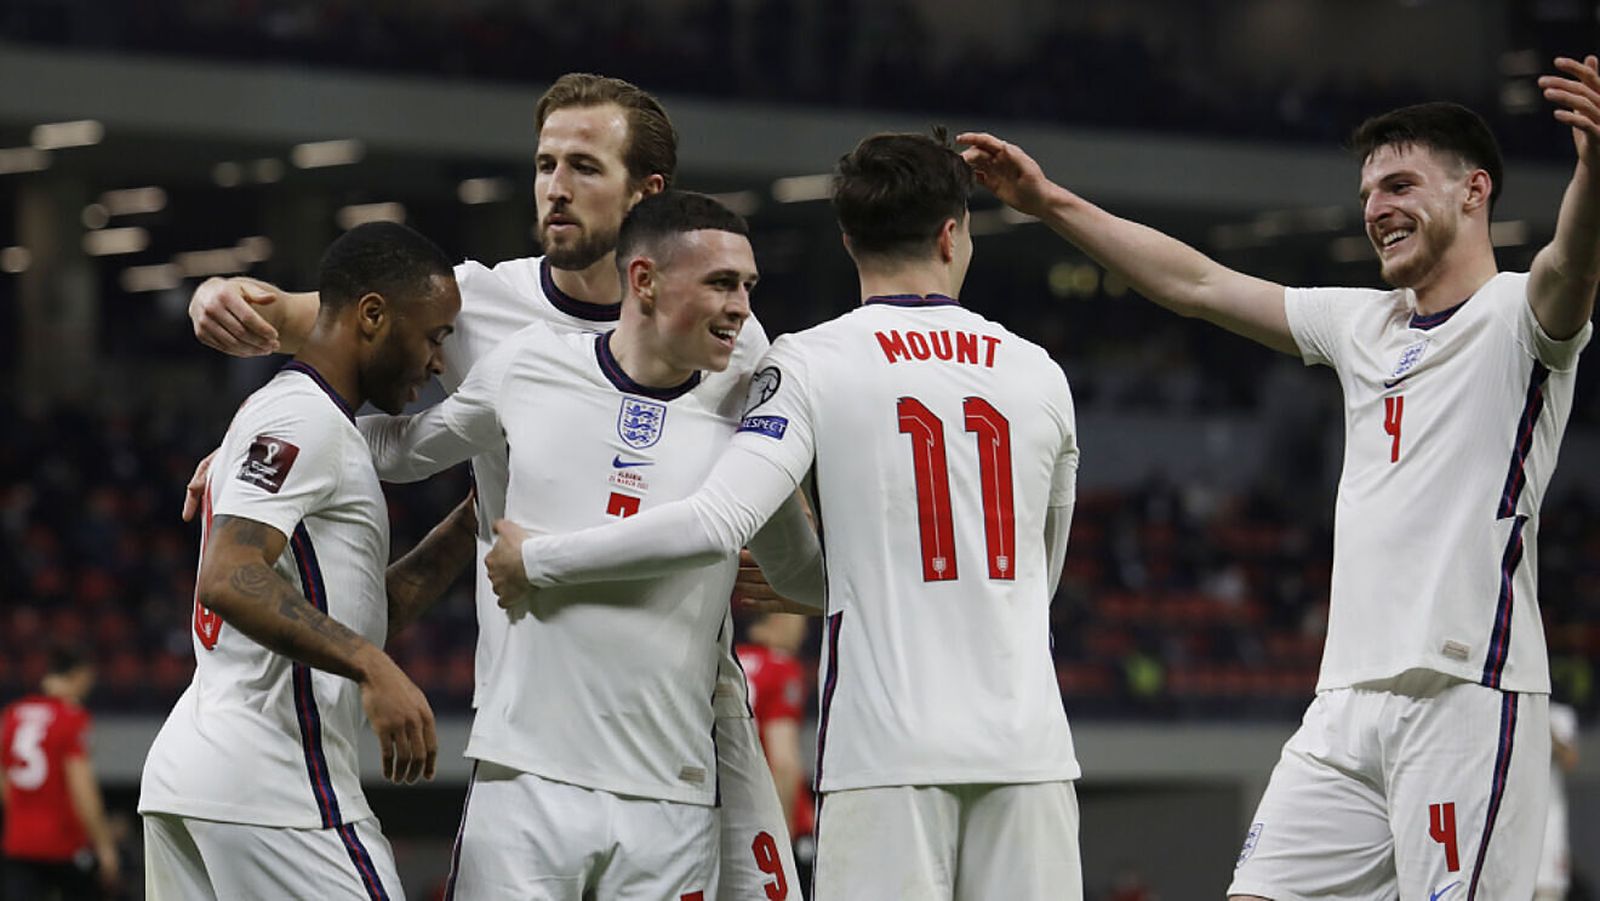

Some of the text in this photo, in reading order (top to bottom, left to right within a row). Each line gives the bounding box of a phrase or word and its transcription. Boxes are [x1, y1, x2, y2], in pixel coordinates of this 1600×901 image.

[875, 329, 1002, 368] MOUNT
[1384, 395, 1404, 463] 4
[896, 396, 1016, 582] 11
[752, 831, 788, 901] 9
[1429, 801, 1460, 873] 4
